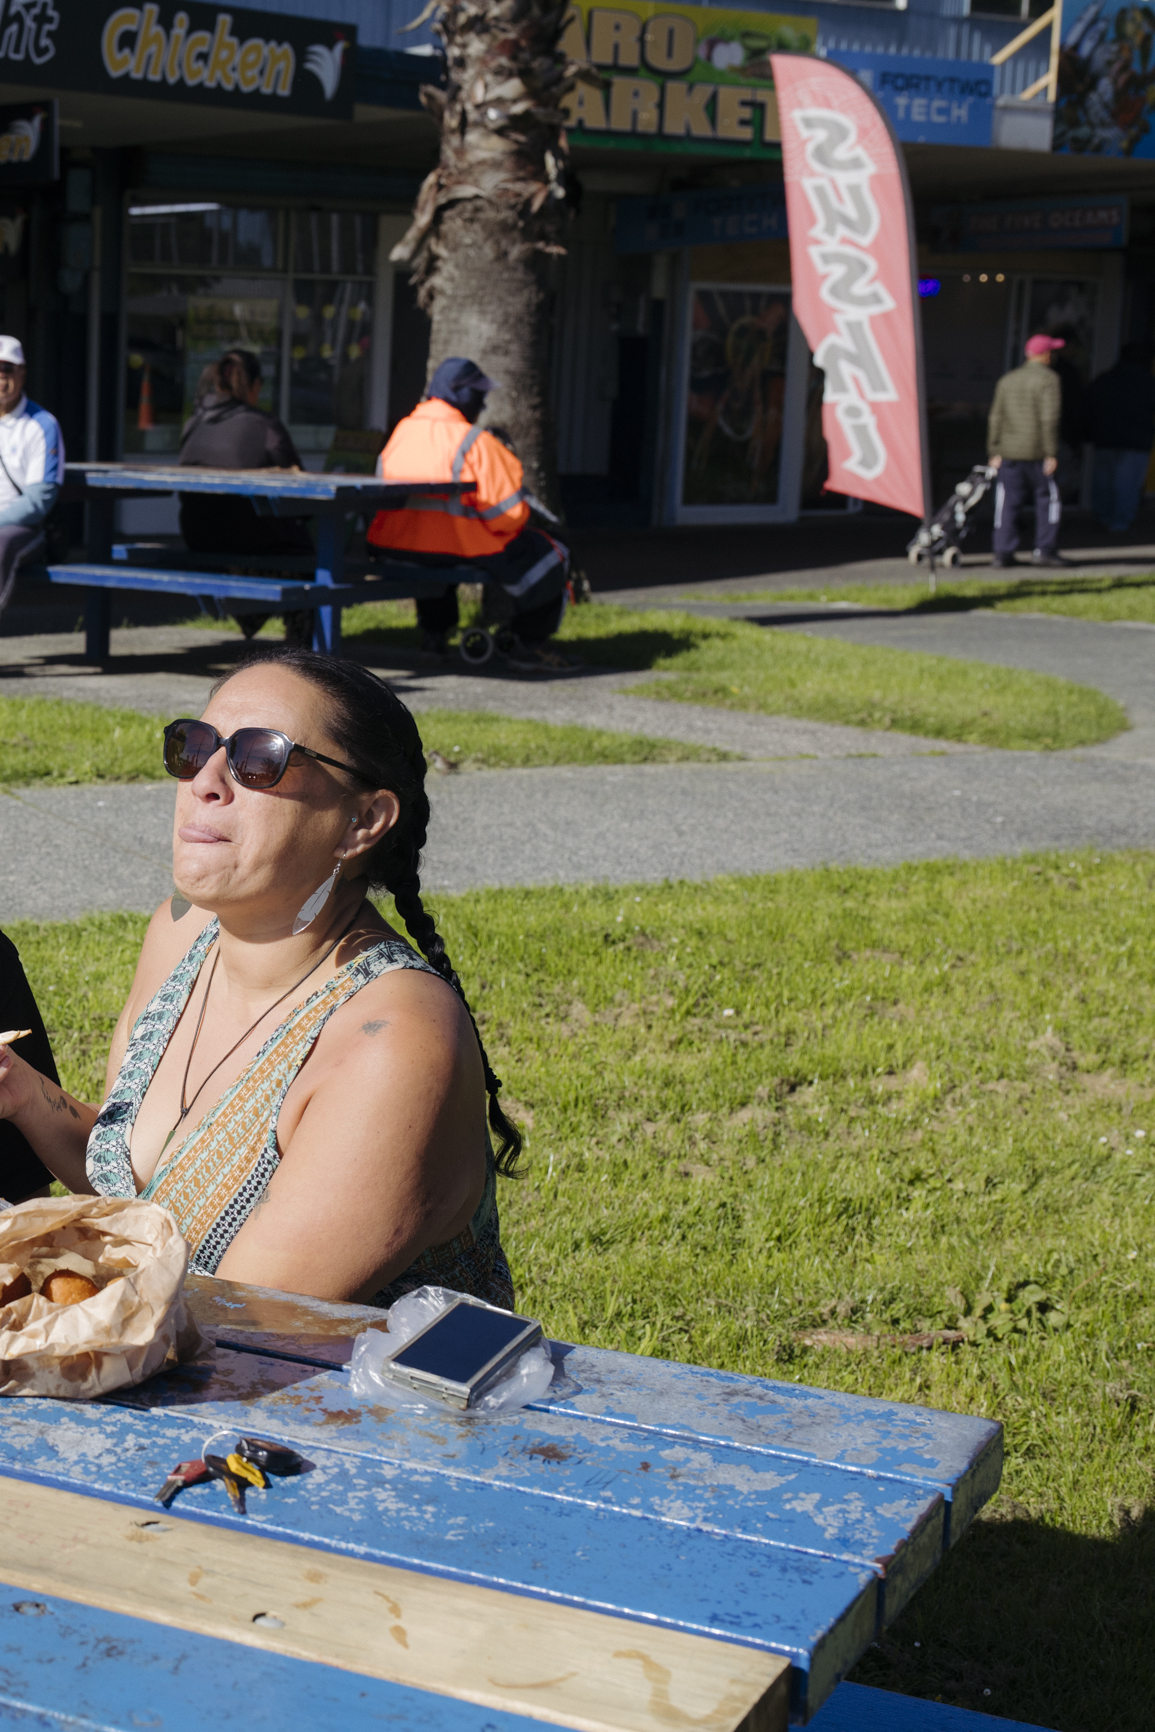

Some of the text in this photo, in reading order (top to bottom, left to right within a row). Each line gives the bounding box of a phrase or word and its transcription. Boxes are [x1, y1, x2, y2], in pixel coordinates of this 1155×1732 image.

[102, 1, 295, 97] Chicken
[880, 72, 992, 98] FORTYTWO
[558, 74, 782, 144] ARKET
[894, 95, 970, 124] TECH
[710, 213, 779, 237] TECH
[1047, 205, 1121, 229] OCEANS
